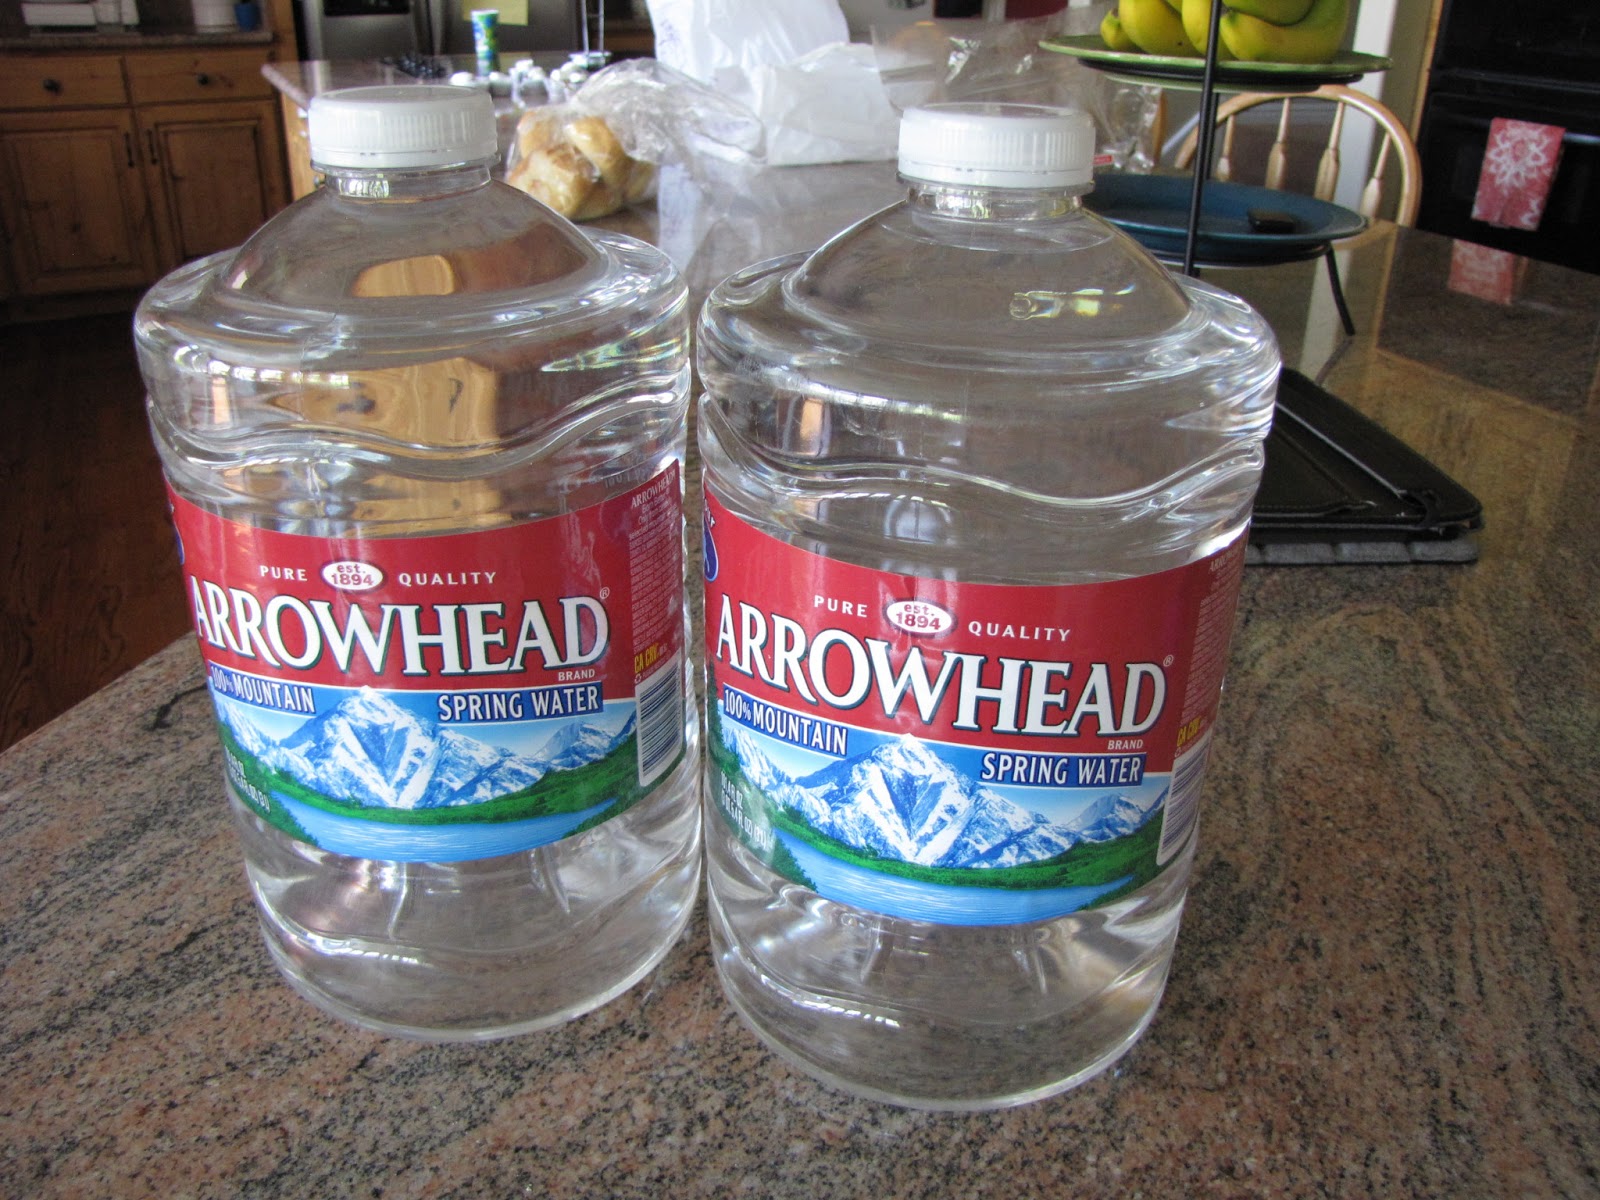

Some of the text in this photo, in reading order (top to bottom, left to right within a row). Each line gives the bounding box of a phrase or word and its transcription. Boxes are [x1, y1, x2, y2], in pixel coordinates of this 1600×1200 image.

[260, 565, 497, 587] PURE QUALITY
[336, 563, 367, 574] est.
[331, 573, 374, 586] 1894
[814, 595, 1071, 642] PURE QUALITY
[903, 602, 935, 617] est.
[896, 612, 941, 630] 1894
[558, 668, 596, 682] BRAND
[232, 673, 315, 713] MOUNTAIN
[438, 685, 599, 721] SPRING WATER
[724, 689, 848, 756] 100% MOUNTAIN
[1108, 739, 1144, 751] BRAND
[981, 752, 1142, 785] SPRING WATER
